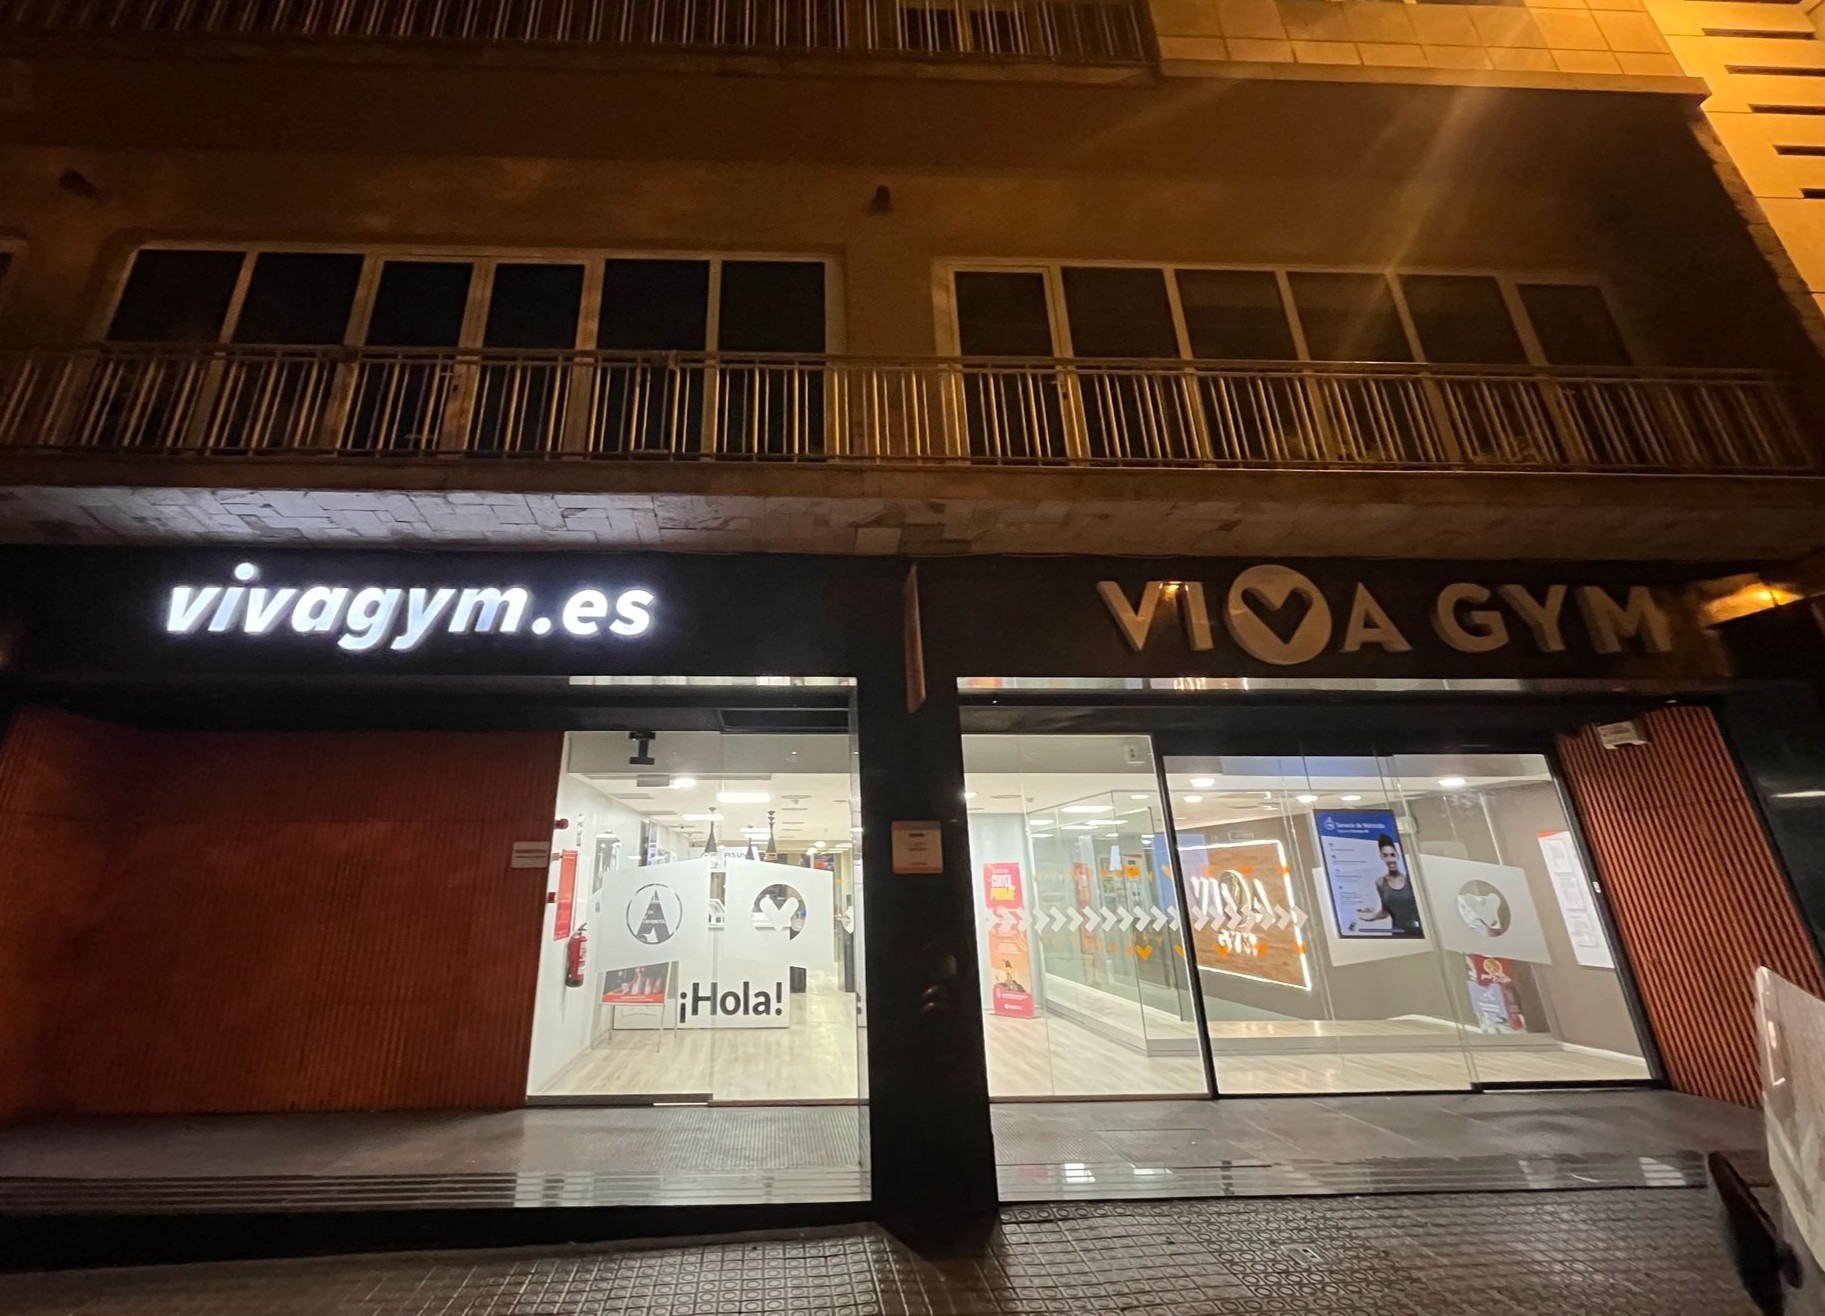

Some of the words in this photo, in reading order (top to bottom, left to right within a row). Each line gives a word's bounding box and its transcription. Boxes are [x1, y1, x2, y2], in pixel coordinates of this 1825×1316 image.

[164, 562, 657, 652] vivagym.es
[1431, 581, 1675, 655] GYM
[679, 981, 783, 1024] ¡Hola!
